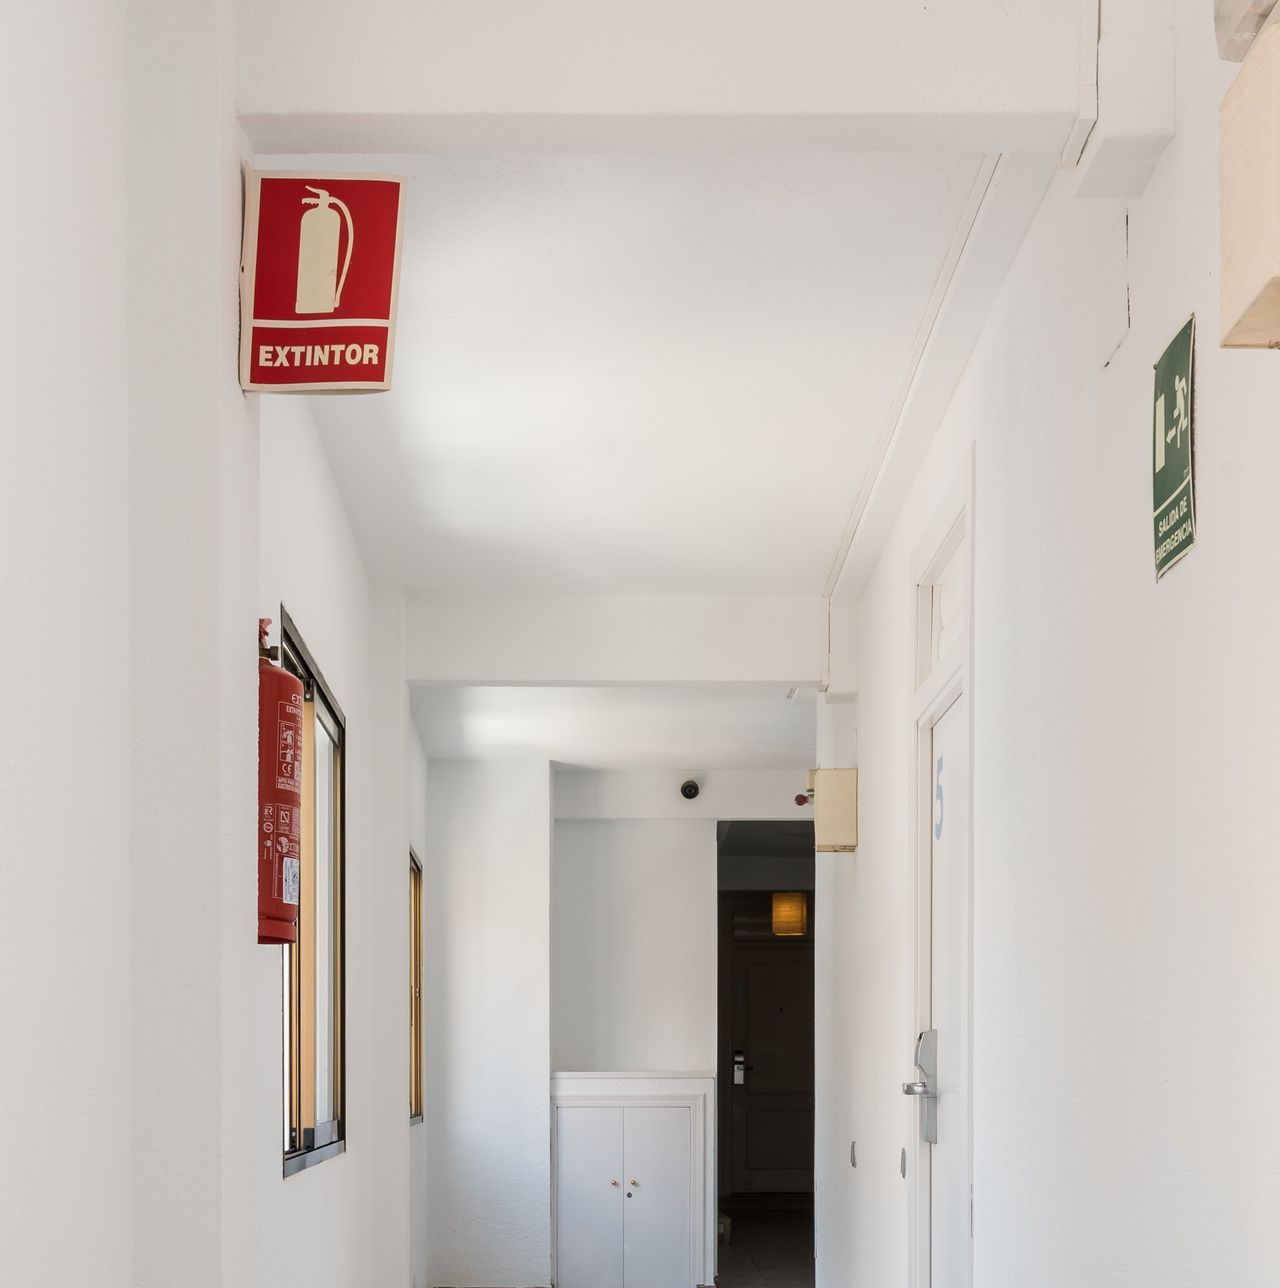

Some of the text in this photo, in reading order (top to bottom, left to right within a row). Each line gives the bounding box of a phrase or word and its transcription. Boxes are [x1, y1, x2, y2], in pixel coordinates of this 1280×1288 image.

[258, 344, 379, 367] EXTINTOR
[1159, 496, 1188, 538] SALIDA DE
[1155, 518, 1193, 565] EMERGENCIA
[934, 754, 944, 841] 5
